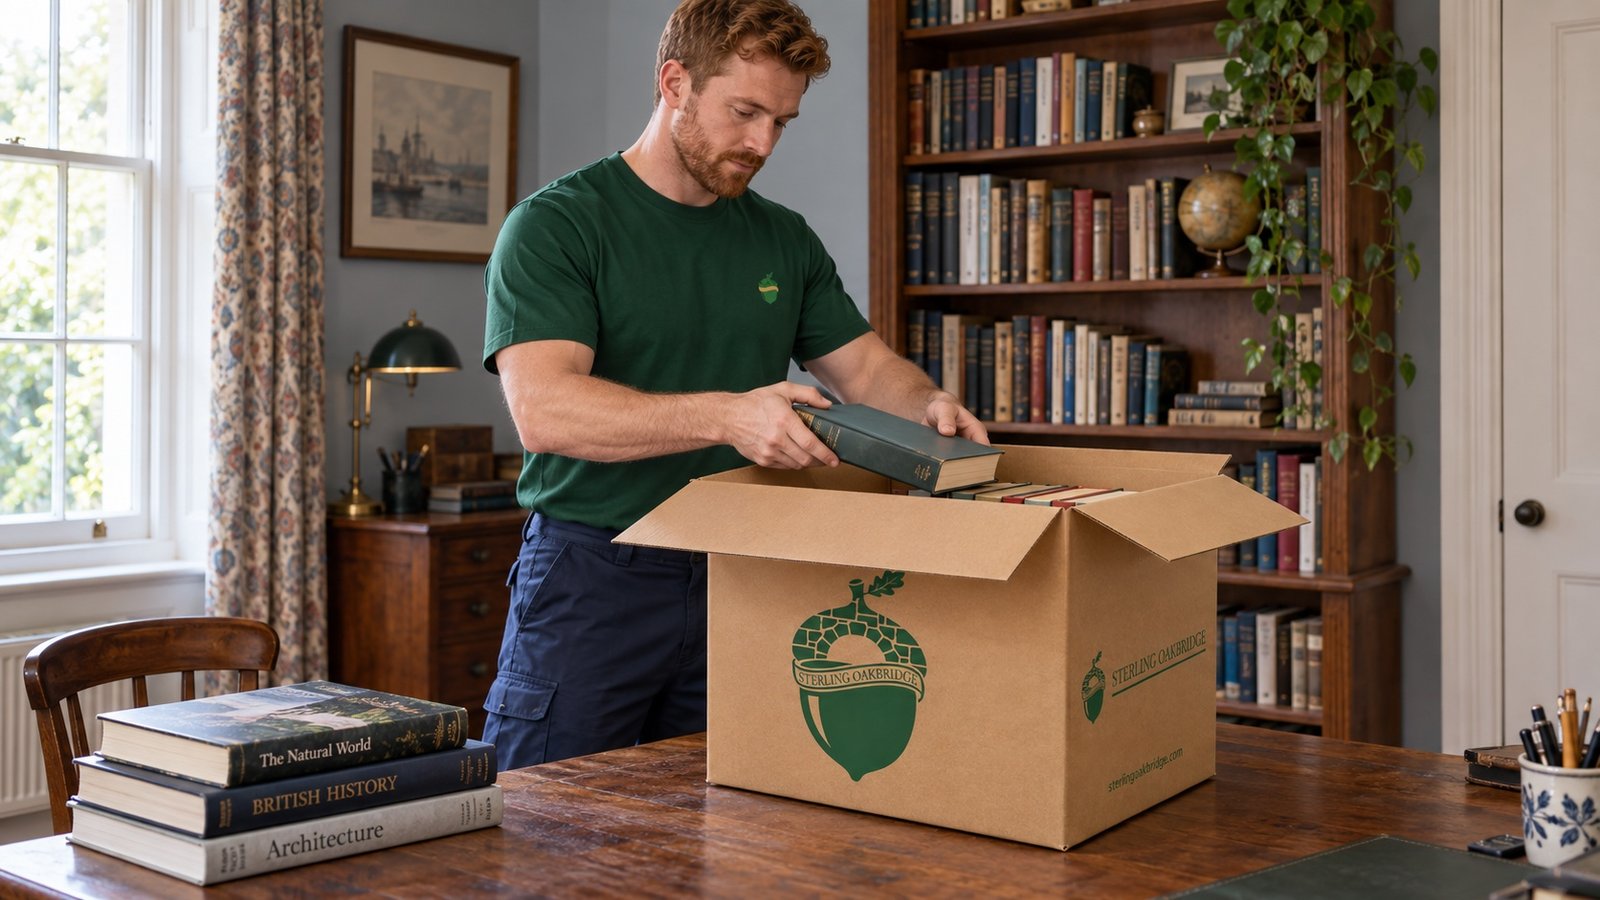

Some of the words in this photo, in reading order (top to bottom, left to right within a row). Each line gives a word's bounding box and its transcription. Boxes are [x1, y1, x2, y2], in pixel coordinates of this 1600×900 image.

[1112, 652, 1156, 687] STERLING
[1158, 629, 1206, 664] OAKBRIDGE
[798, 671, 850, 687] STERLING
[852, 668, 918, 687] OAKBRIDGE
[259, 751, 285, 768] The
[287, 743, 333, 764] Natural
[336, 736, 372, 755] World
[1108, 747, 1184, 793] sterlingoakbridge.com
[252, 789, 320, 816] BRITISH
[327, 775, 398, 802] HISTORY
[266, 824, 384, 860] Architecture
